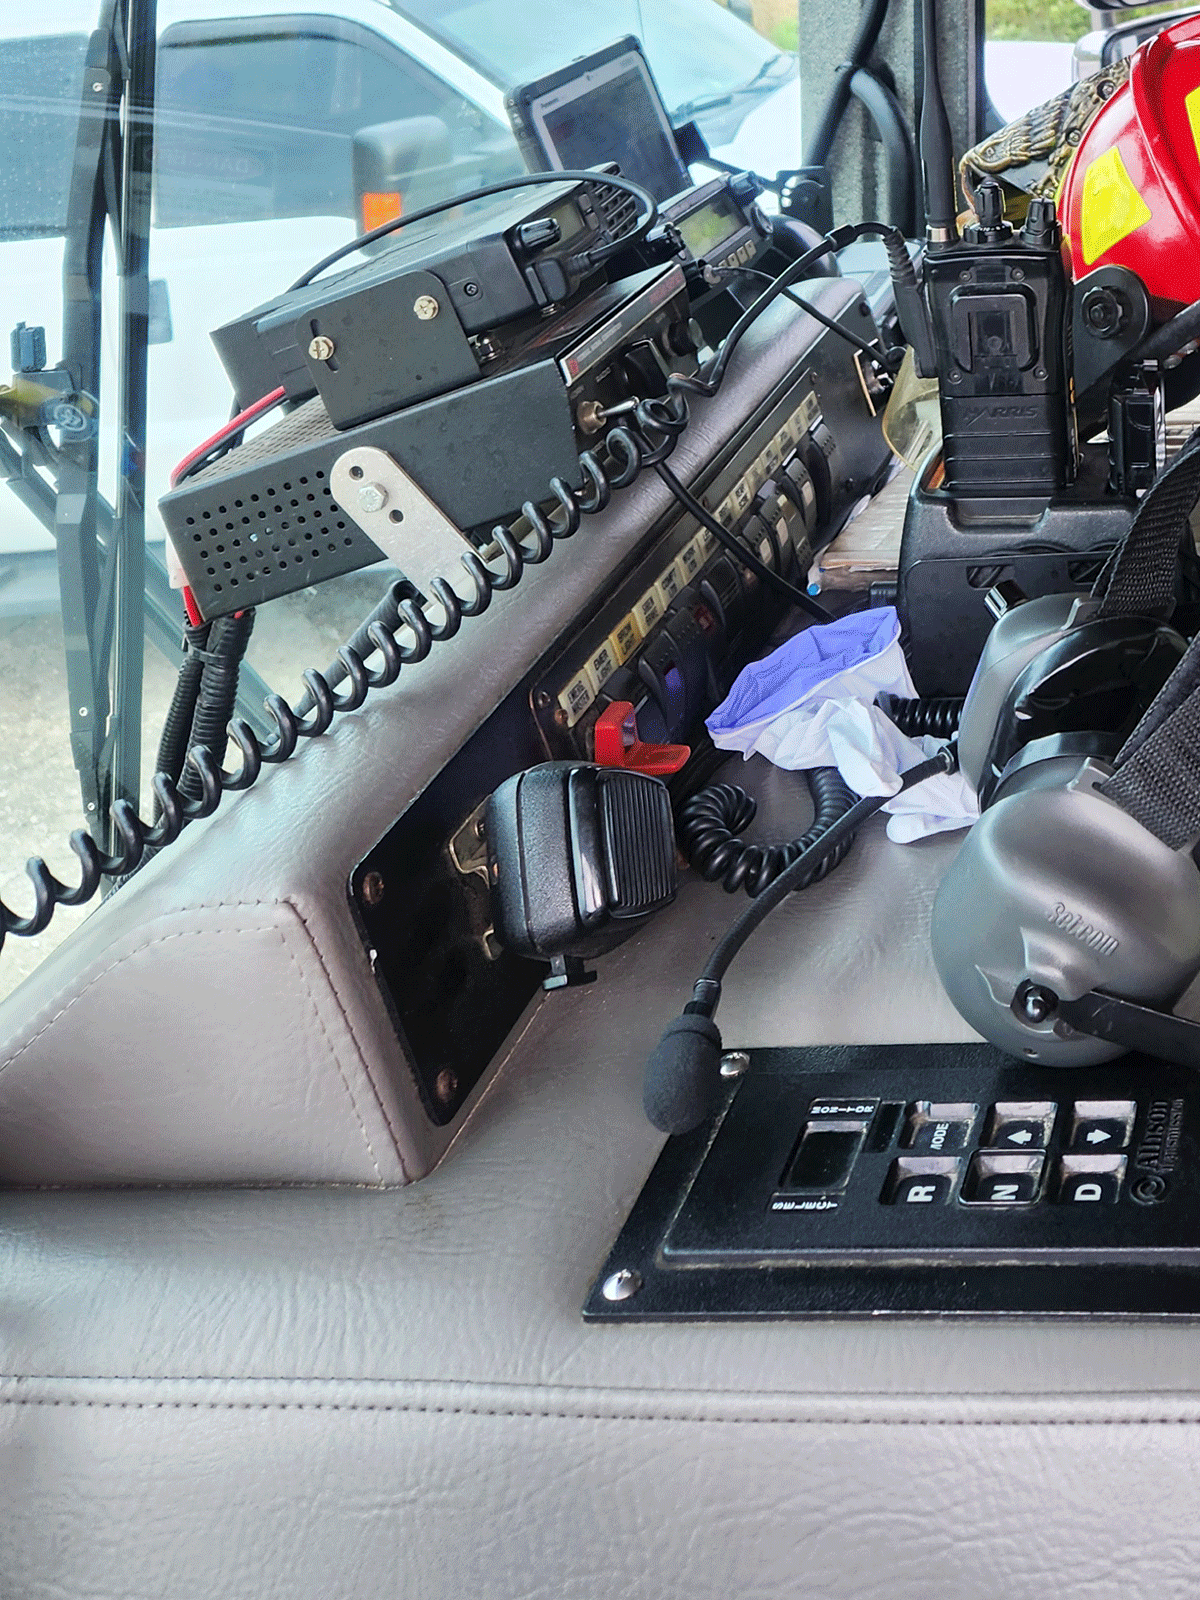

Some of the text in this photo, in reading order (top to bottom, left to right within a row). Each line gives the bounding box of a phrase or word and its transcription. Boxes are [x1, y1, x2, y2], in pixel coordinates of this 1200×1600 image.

[963, 404, 1039, 424] HARRIS
[1048, 902, 1120, 956] Setcom
[811, 1105, 875, 1115] MONITOR
[1136, 1100, 1168, 1172] Allison
[906, 1185, 937, 1203] R
[990, 1184, 1020, 1201] N
[1073, 1183, 1102, 1202] D
[771, 1201, 838, 1211] SELECT
